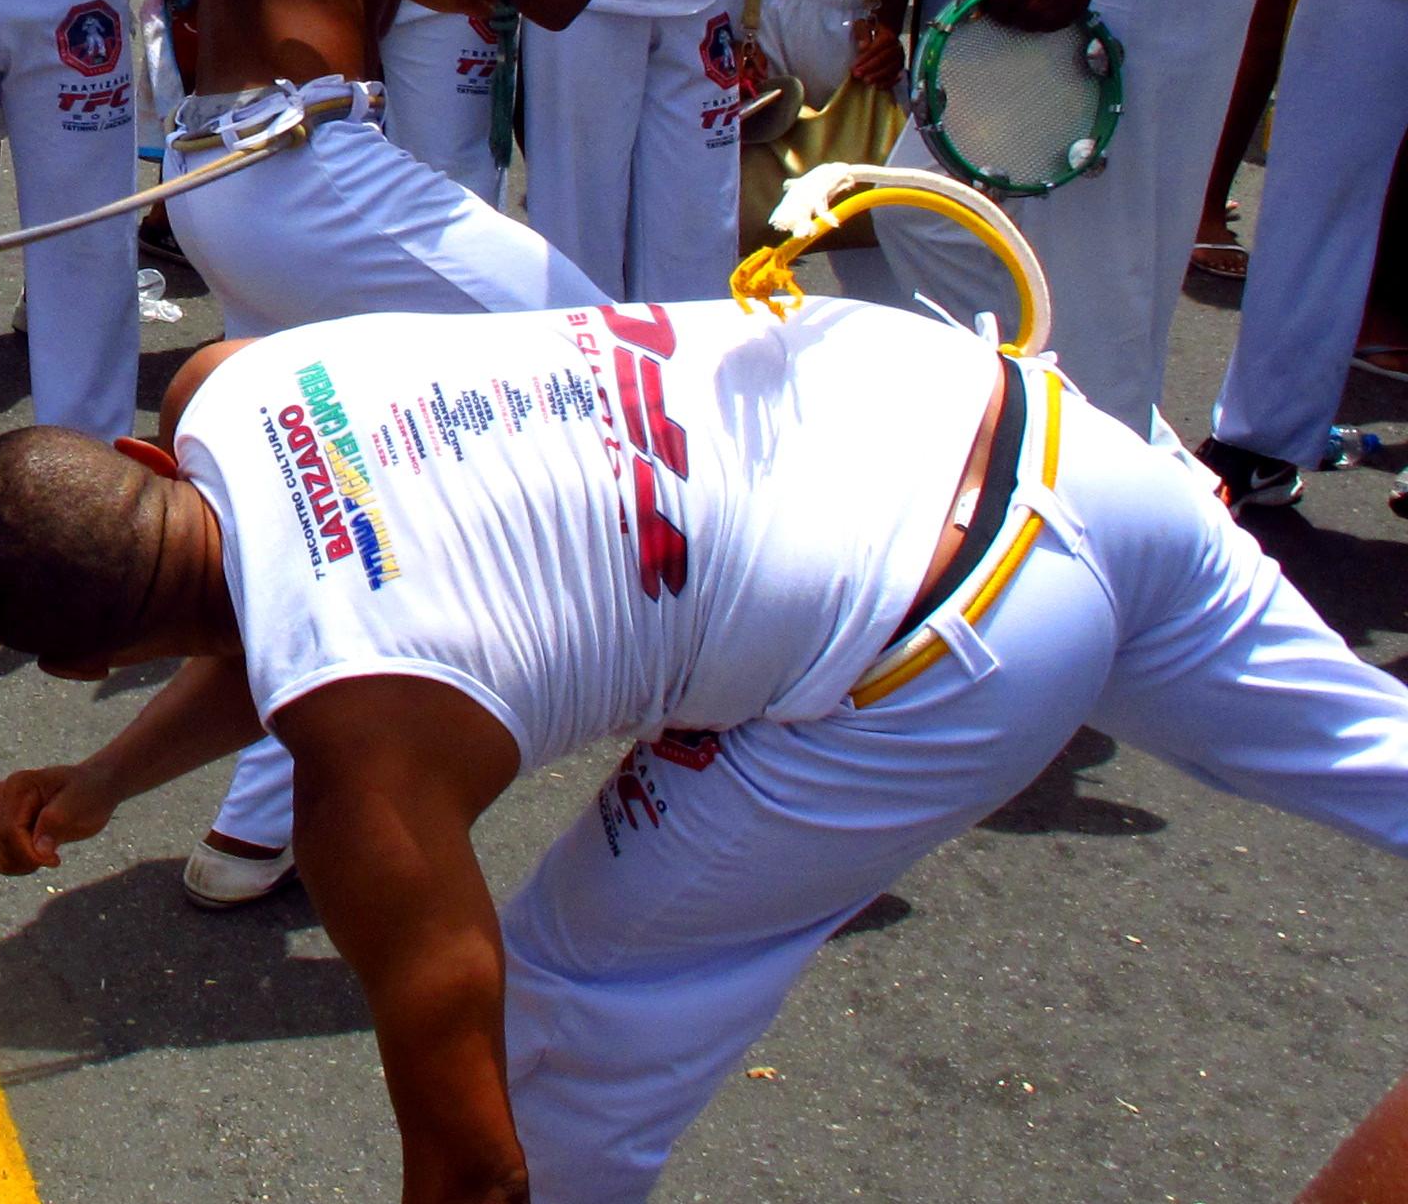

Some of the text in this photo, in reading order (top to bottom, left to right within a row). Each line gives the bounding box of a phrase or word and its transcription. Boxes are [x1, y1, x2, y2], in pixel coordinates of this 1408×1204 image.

[58, 83, 130, 114] TFC
[432, 382, 464, 462] PAULO VANDAME
[450, 408, 461, 427] DEL
[455, 398, 471, 431] MINGO
[461, 390, 482, 436] KENNEDY
[470, 389, 489, 430] ROBSON
[492, 378, 513, 436] INSTRUTORES
[502, 380, 522, 432] NEGUINHO
[523, 392, 533, 411] VAL
[544, 383, 558, 415] PABLO
[550, 372, 567, 422] PAULINHO
[380, 424, 399, 466] TATINHO
[390, 402, 421, 475] CONTRA-MESTRE
[404, 409, 427, 459] PEDRINHO
[417, 396, 442, 457] PROFESSORES
[429, 400, 451, 446] JACKSON
[263, 415, 297, 489] CULTURAL
[372, 433, 388, 467] MESTRE
[597, 303, 688, 603] TFC
[278, 404, 354, 563] BATIZADO
[295, 360, 402, 591] TATINHO FIGHTER CAPOEIRA
[292, 491, 324, 567] ENCONTRO
